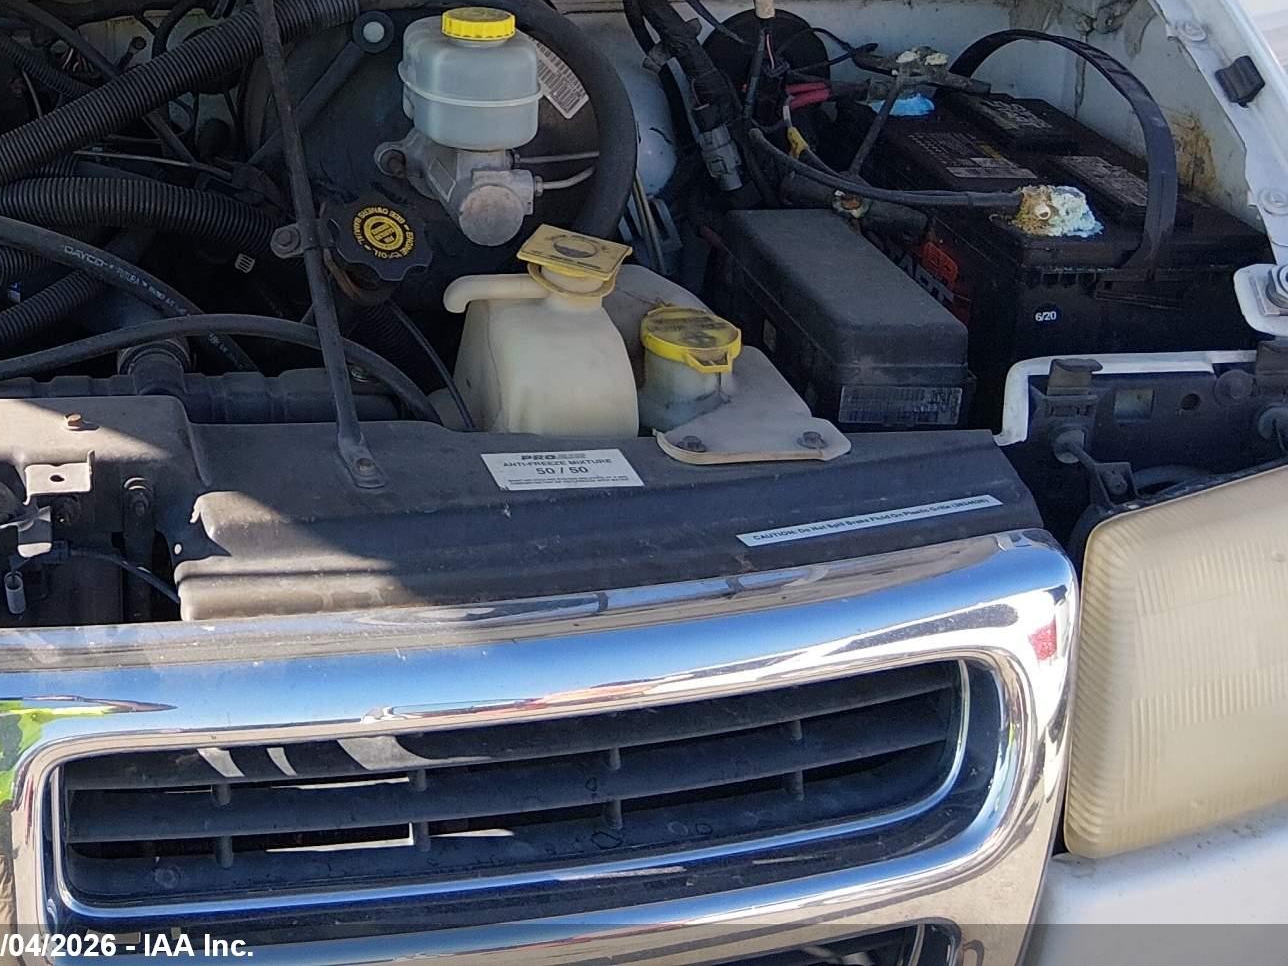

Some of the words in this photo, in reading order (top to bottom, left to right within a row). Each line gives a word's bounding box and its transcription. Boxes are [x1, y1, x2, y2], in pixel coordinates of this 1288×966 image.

[1035, 310, 1057, 321] 6/20
[568, 458, 612, 466] MIXTURE
[536, 467, 556, 475] 50
[569, 466, 589, 474] 50
